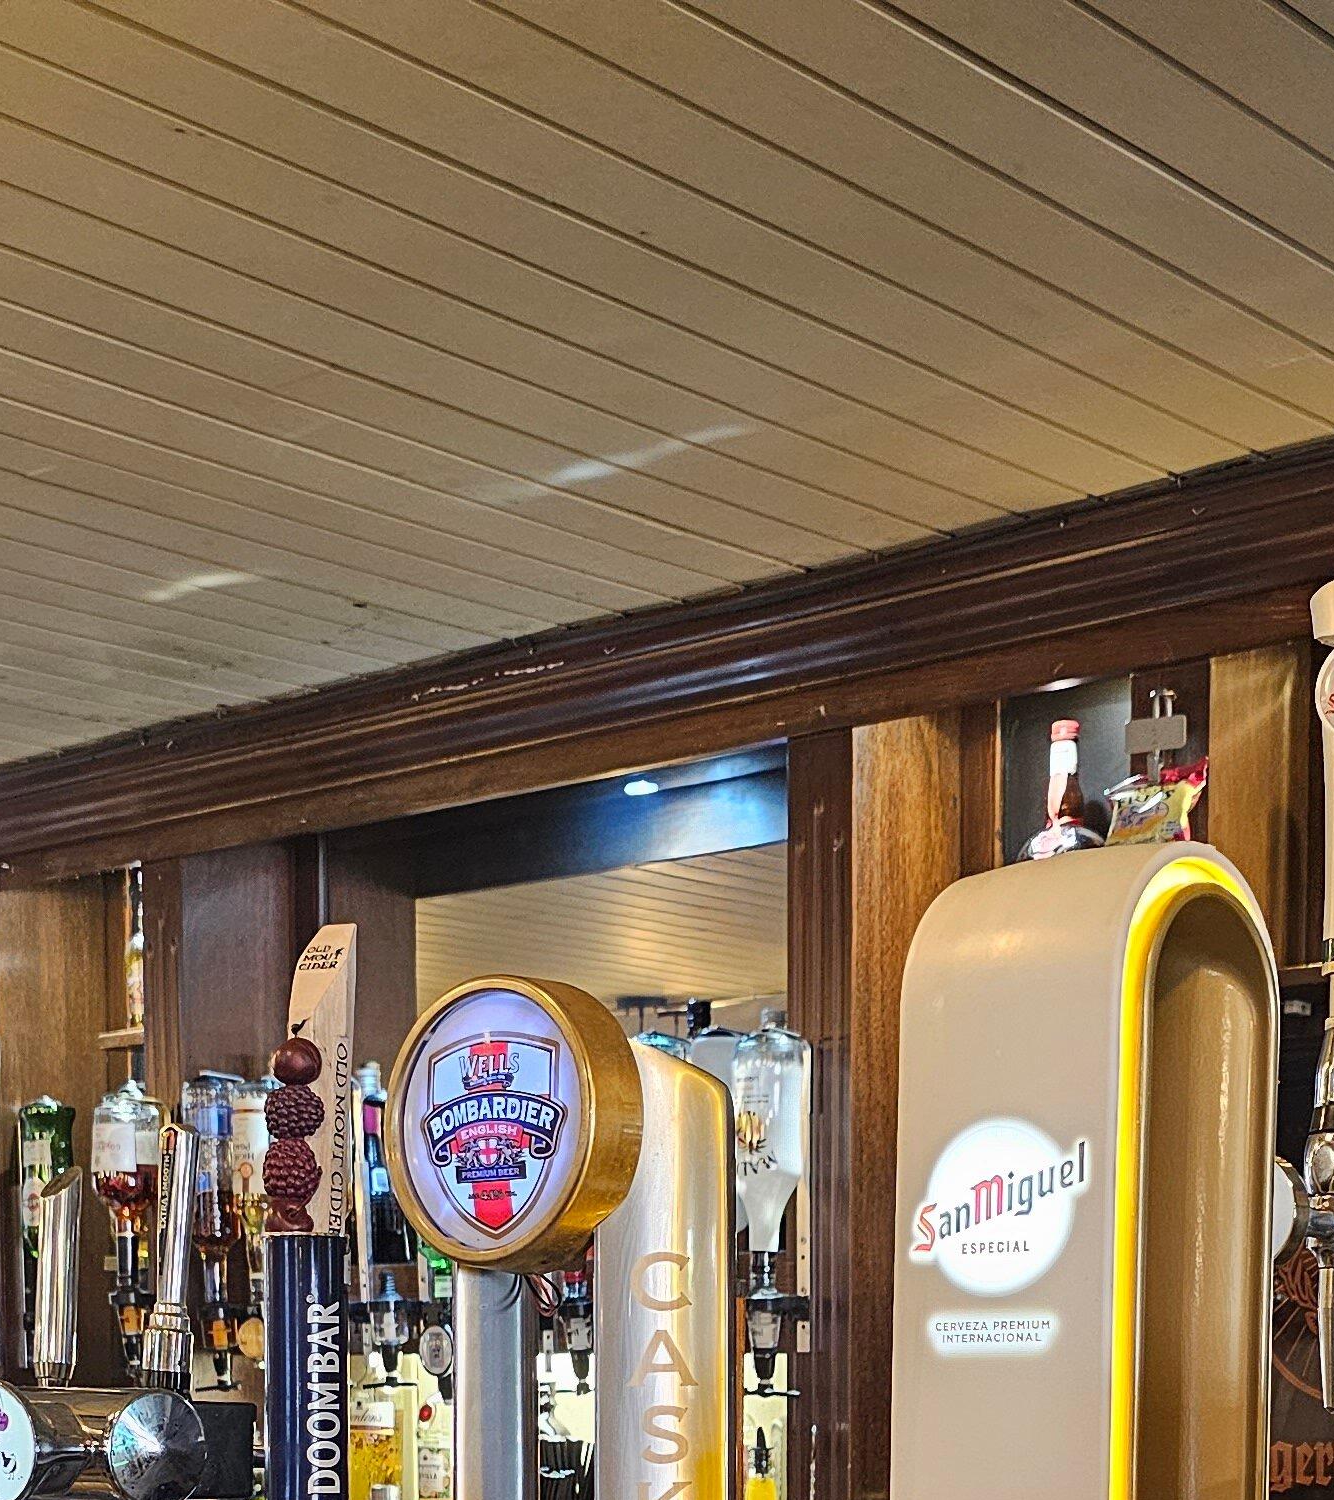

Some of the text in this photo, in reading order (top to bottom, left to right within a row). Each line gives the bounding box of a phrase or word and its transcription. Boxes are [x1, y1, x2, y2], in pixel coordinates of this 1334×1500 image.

[307, 946, 331, 954] OLD
[298, 960, 338, 971] CIDER
[335, 1042, 348, 1088] OLD
[459, 1052, 520, 1079] WELLS
[429, 1096, 555, 1141] BOMBARDIER
[329, 1094, 347, 1166] MOUT
[461, 1124, 517, 1140] ENGLISH
[461, 1167, 520, 1179] PREMIUM BEER
[961, 1240, 1030, 1254] ESPECIAL
[935, 1319, 1051, 1331] CERVEZA PREMIUM
[942, 1333, 1042, 1343] INTERNACIONAL
[307, 1382, 341, 1494] DOOM
